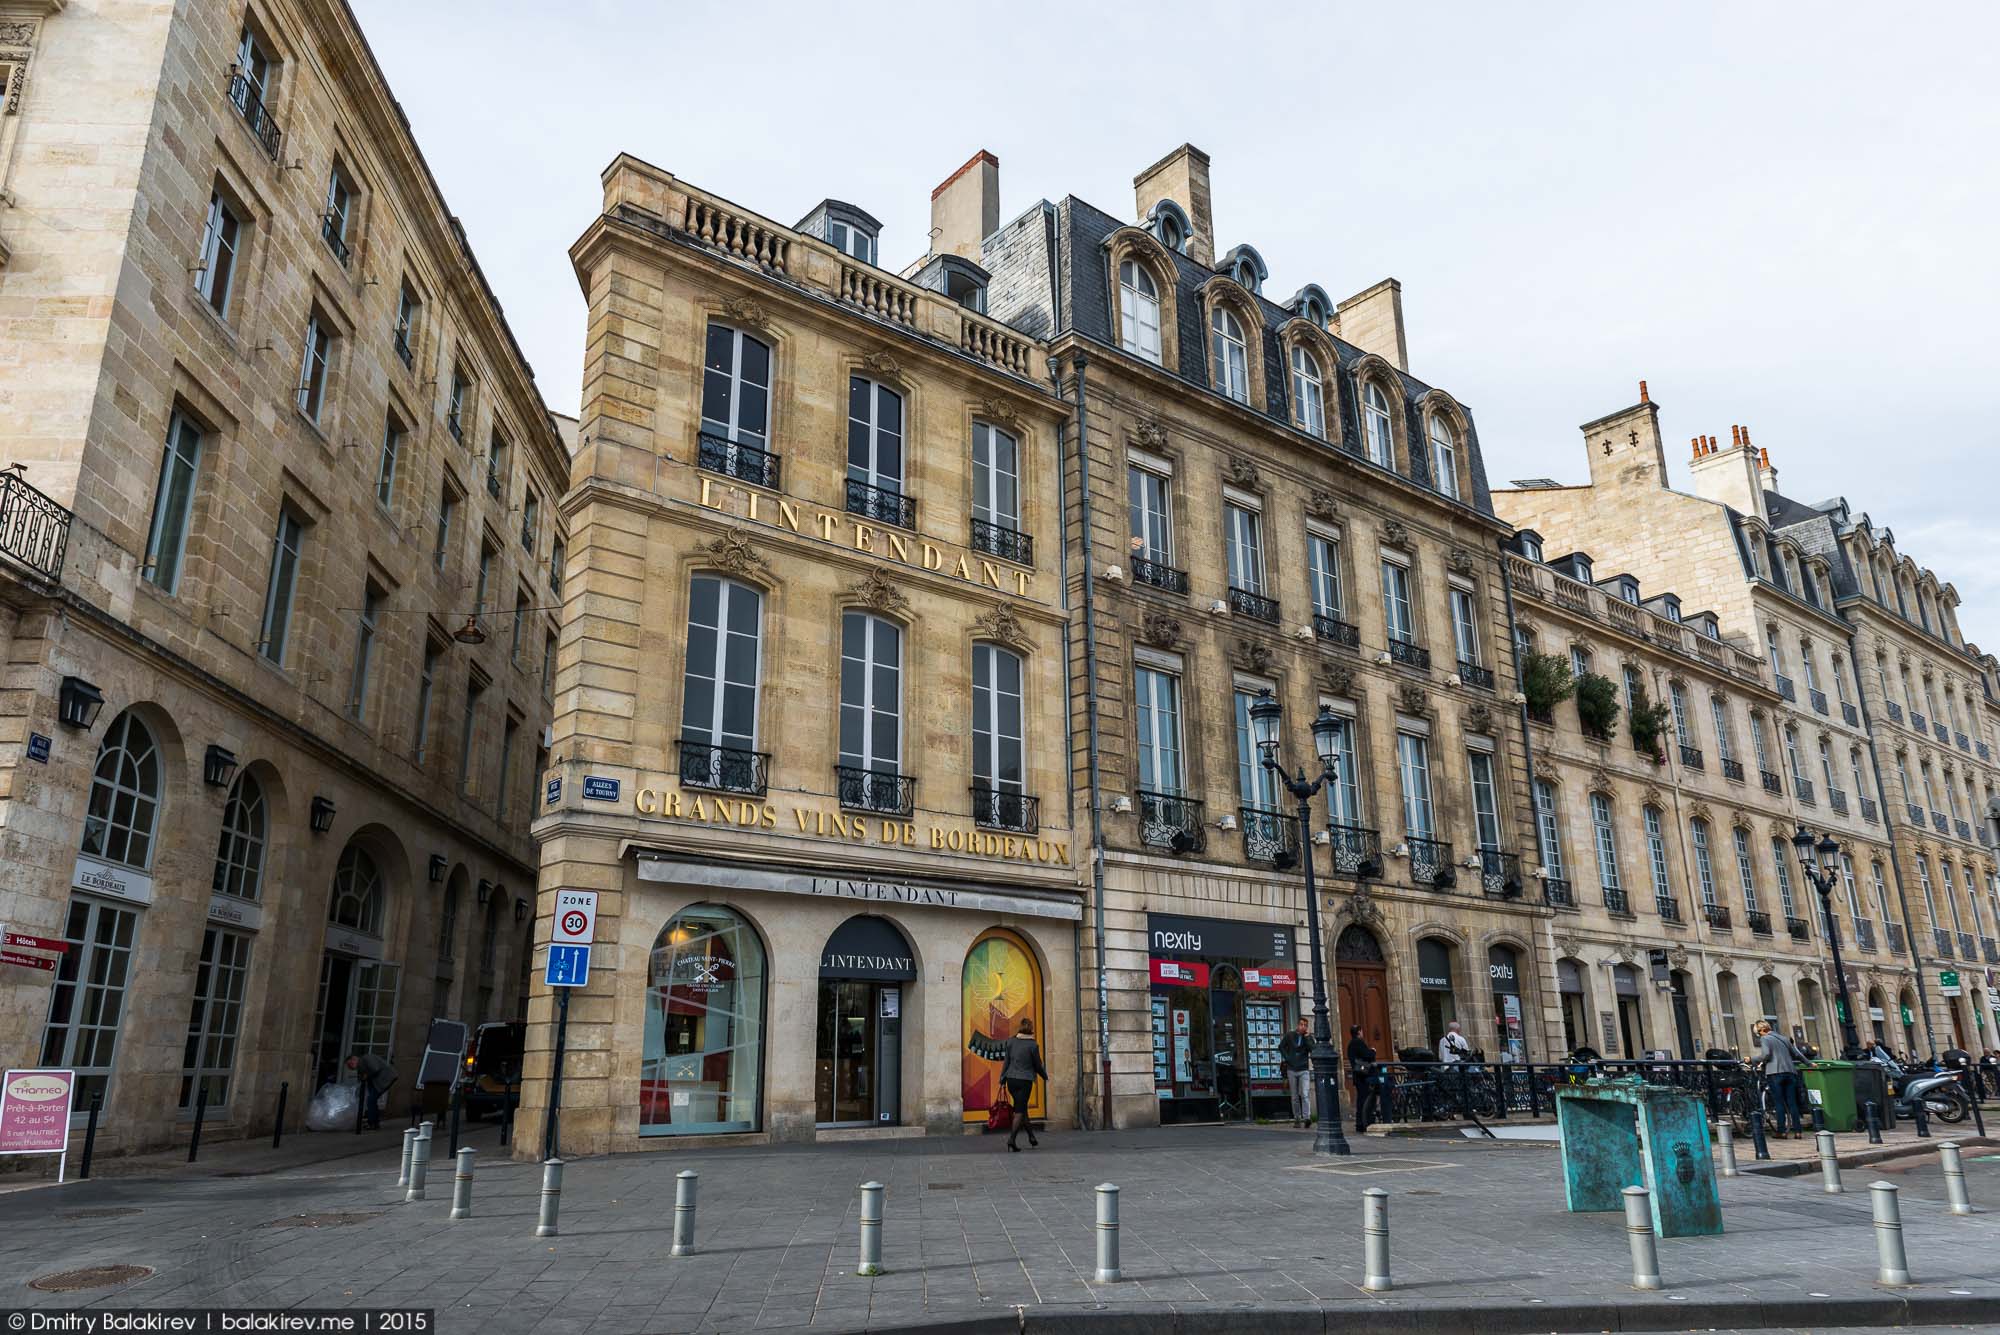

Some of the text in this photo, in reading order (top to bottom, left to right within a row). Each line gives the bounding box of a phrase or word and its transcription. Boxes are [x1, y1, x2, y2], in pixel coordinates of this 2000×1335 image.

[700, 477, 1032, 596] L'INTENDANT
[596, 789, 617, 797] TOURNY
[636, 789, 1070, 865] GRANDS VINS DE BORDEAUX
[81, 874, 126, 891] LE BORDEAUX
[812, 878, 958, 905] L'INTENDANT
[563, 896, 591, 905] ZONE
[567, 917, 583, 928] 30
[16, 937, 36, 946] Hôtels
[1154, 931, 1201, 950] nexity
[819, 954, 911, 970] L'INTENDANT
[6, 1104, 65, 1112] Prêt-à-Porter
[14, 1116, 26, 1124] 42
[43, 1115, 55, 1123] 54
